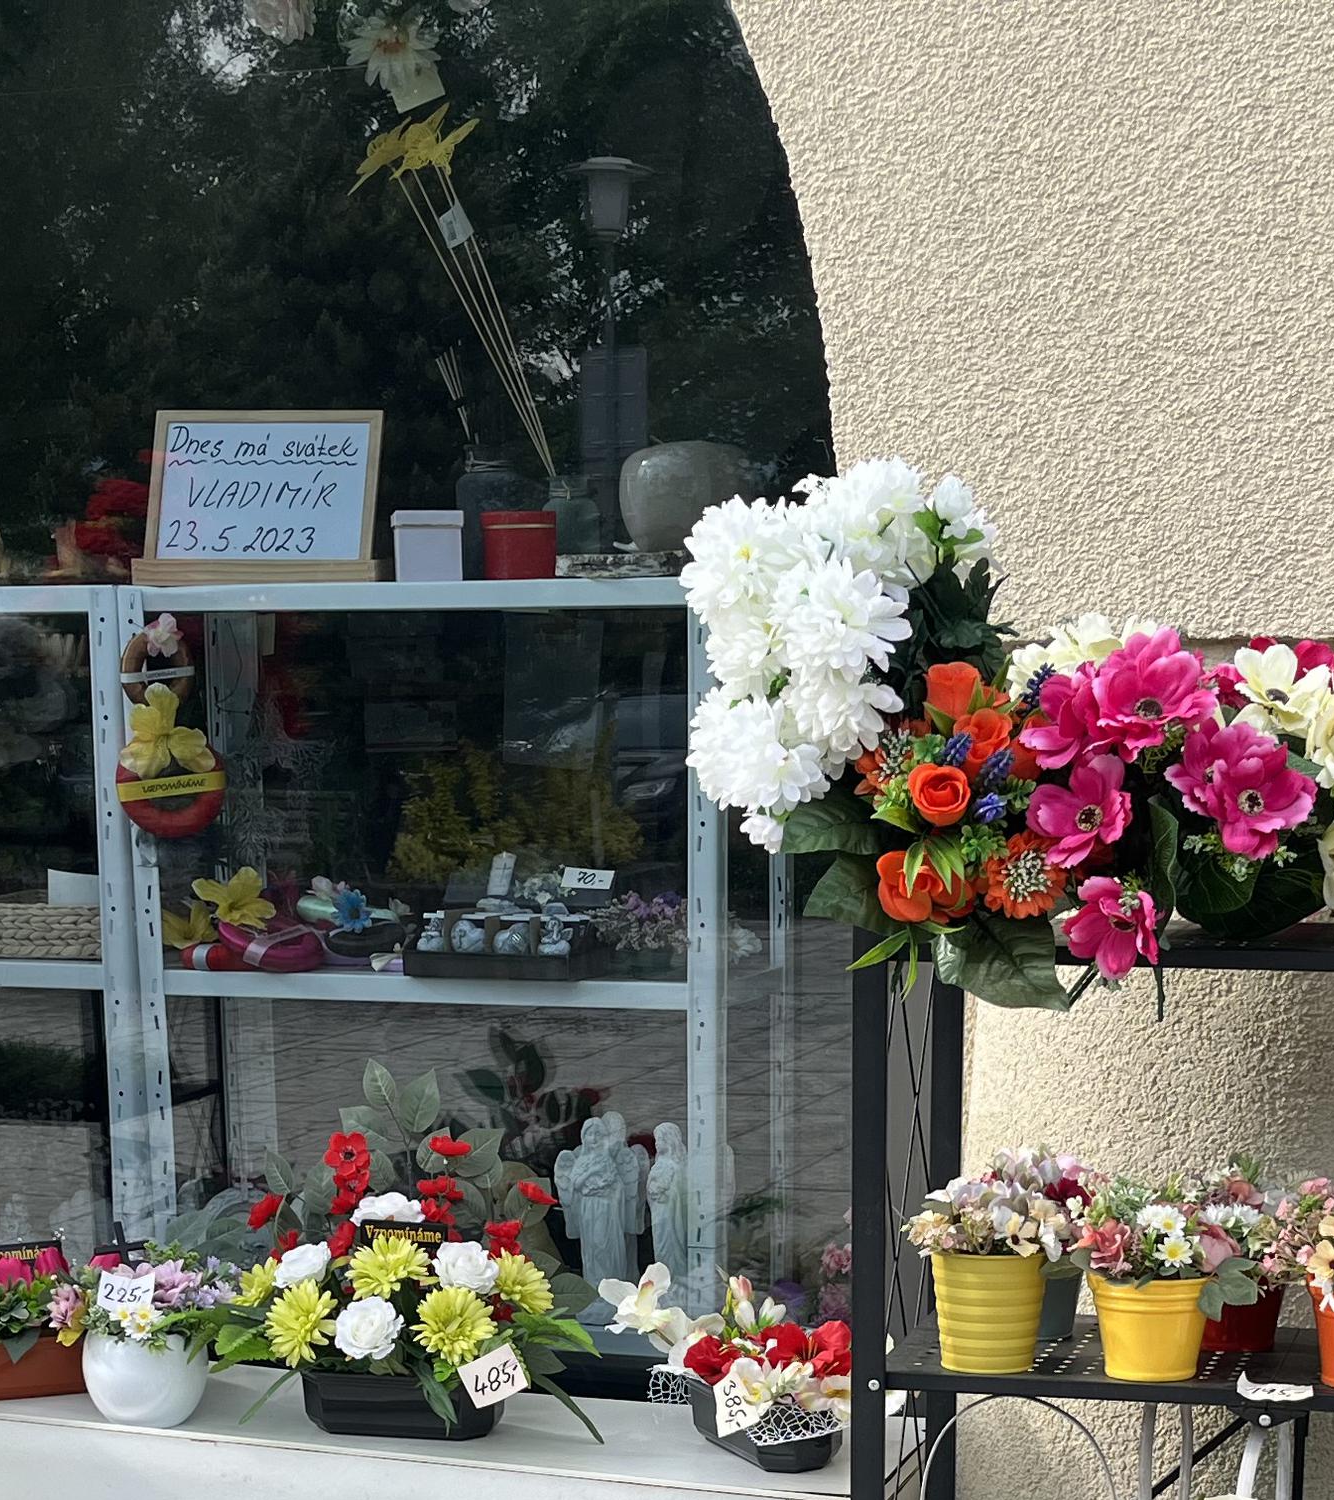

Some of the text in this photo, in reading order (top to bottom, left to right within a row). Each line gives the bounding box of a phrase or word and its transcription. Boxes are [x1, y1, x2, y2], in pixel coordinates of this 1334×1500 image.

[169, 426, 359, 459] Dnes má svátek
[188, 470, 338, 509] VLADIMÍR
[365, 1225, 442, 1243] Vzpomínáme
